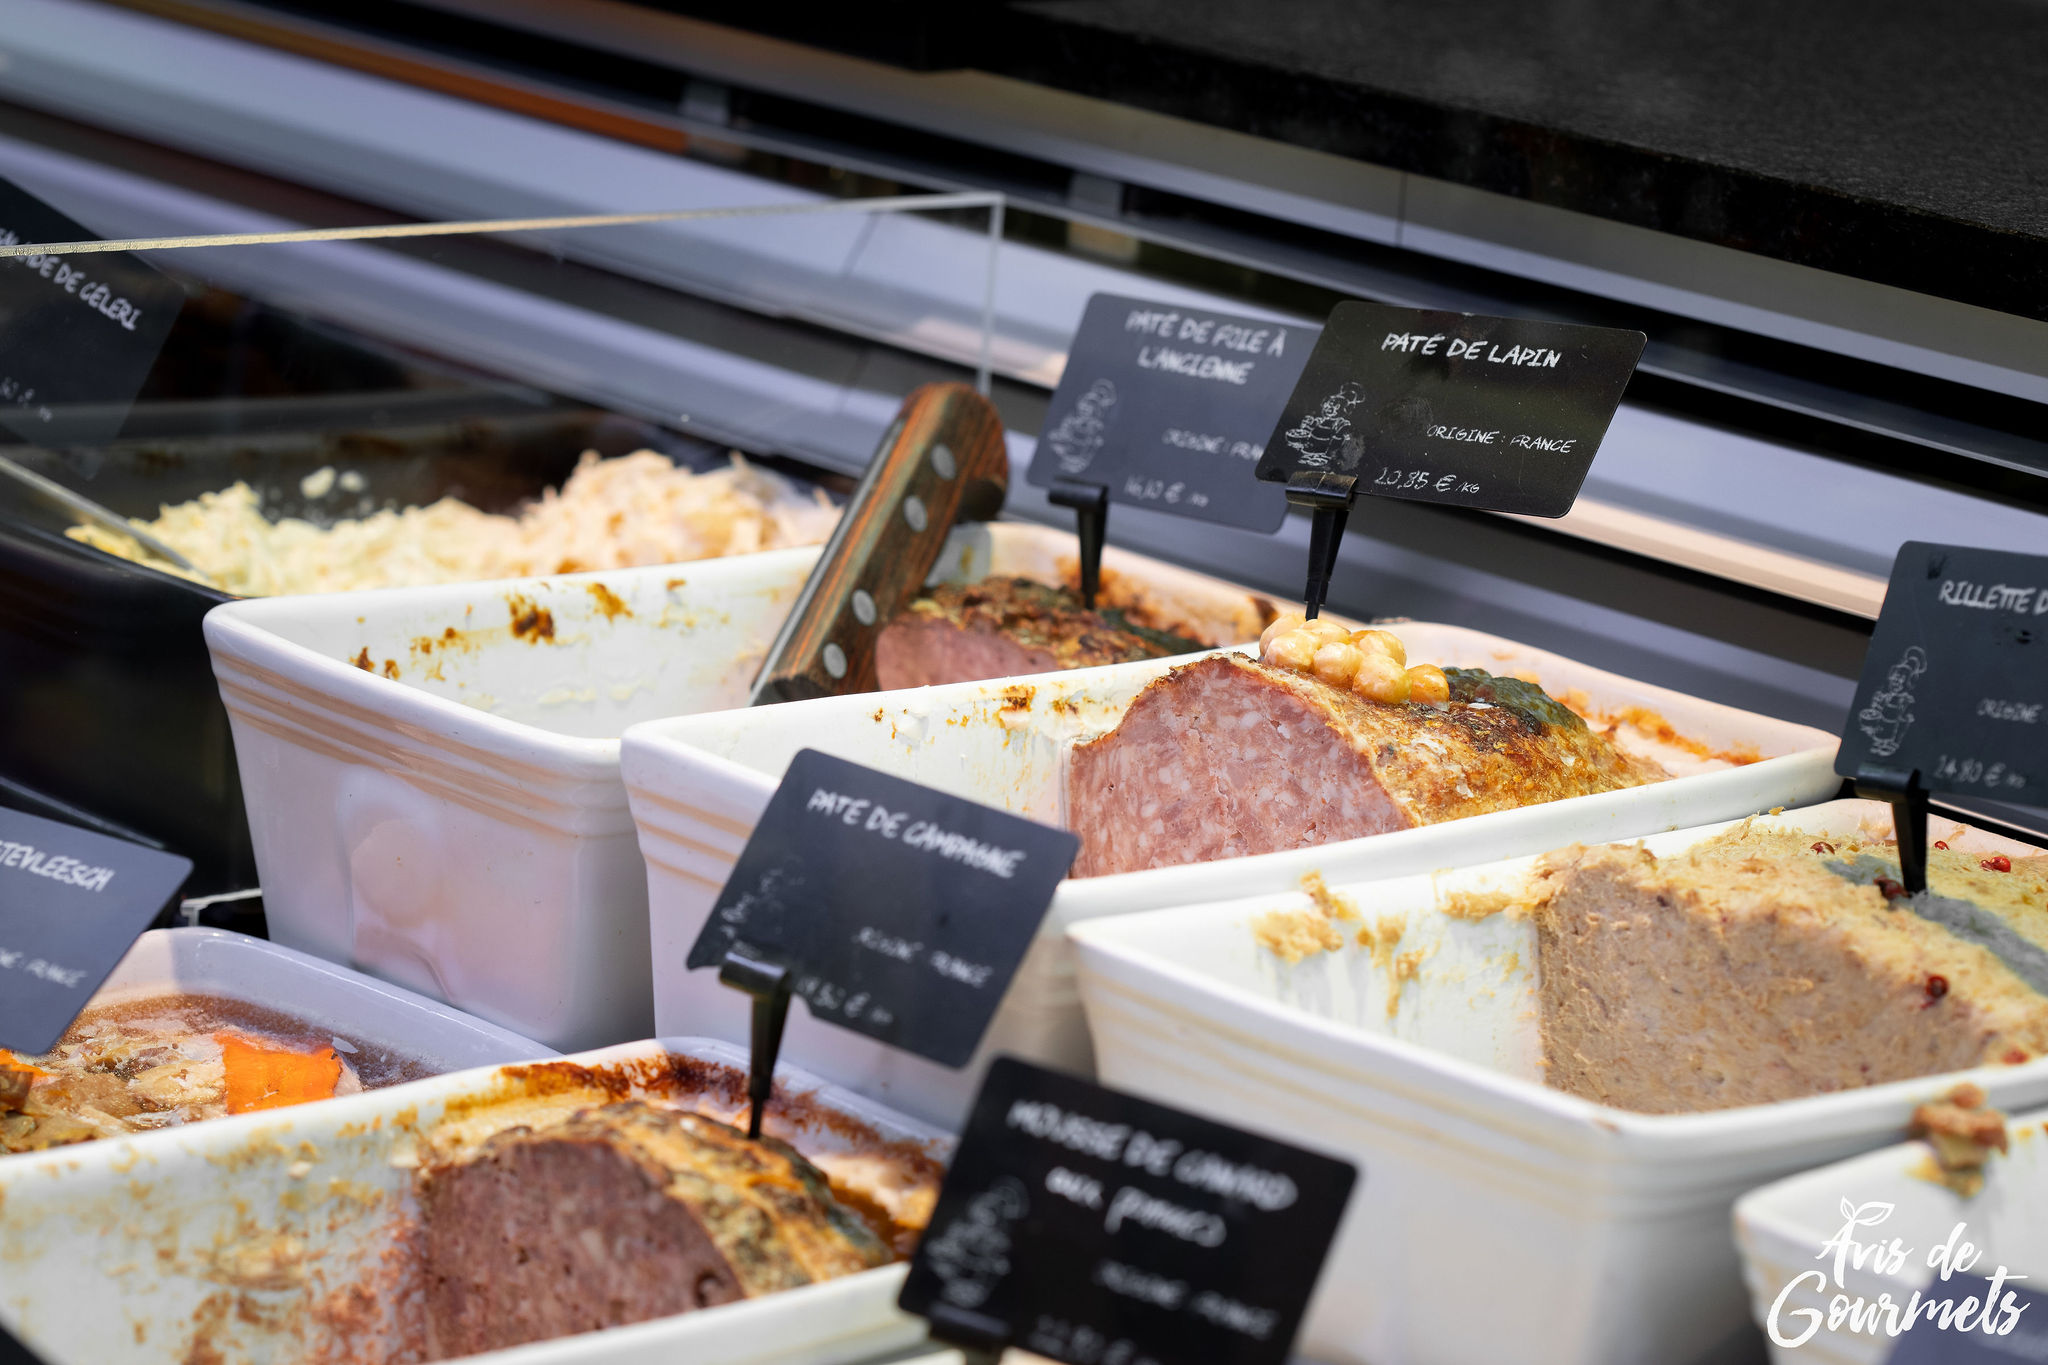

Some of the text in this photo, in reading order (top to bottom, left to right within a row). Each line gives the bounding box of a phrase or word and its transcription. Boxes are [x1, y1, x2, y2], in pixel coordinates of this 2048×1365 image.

[54, 262, 86, 293] DE
[1178, 317, 1215, 344] DE
[1211, 324, 1269, 354] FOIE
[1446, 338, 1488, 360] DE
[1487, 344, 1561, 368] LAPIN
[1427, 424, 1500, 445] ORIGINE
[1509, 433, 1577, 454] FRANCE
[1938, 579, 2036, 615] RILLETTE
[864, 804, 910, 839] DE
[902, 819, 1027, 879] CAMPAGNE
[1006, 1099, 1133, 1162] MOUSSE
[1122, 1129, 1184, 1177] DE
